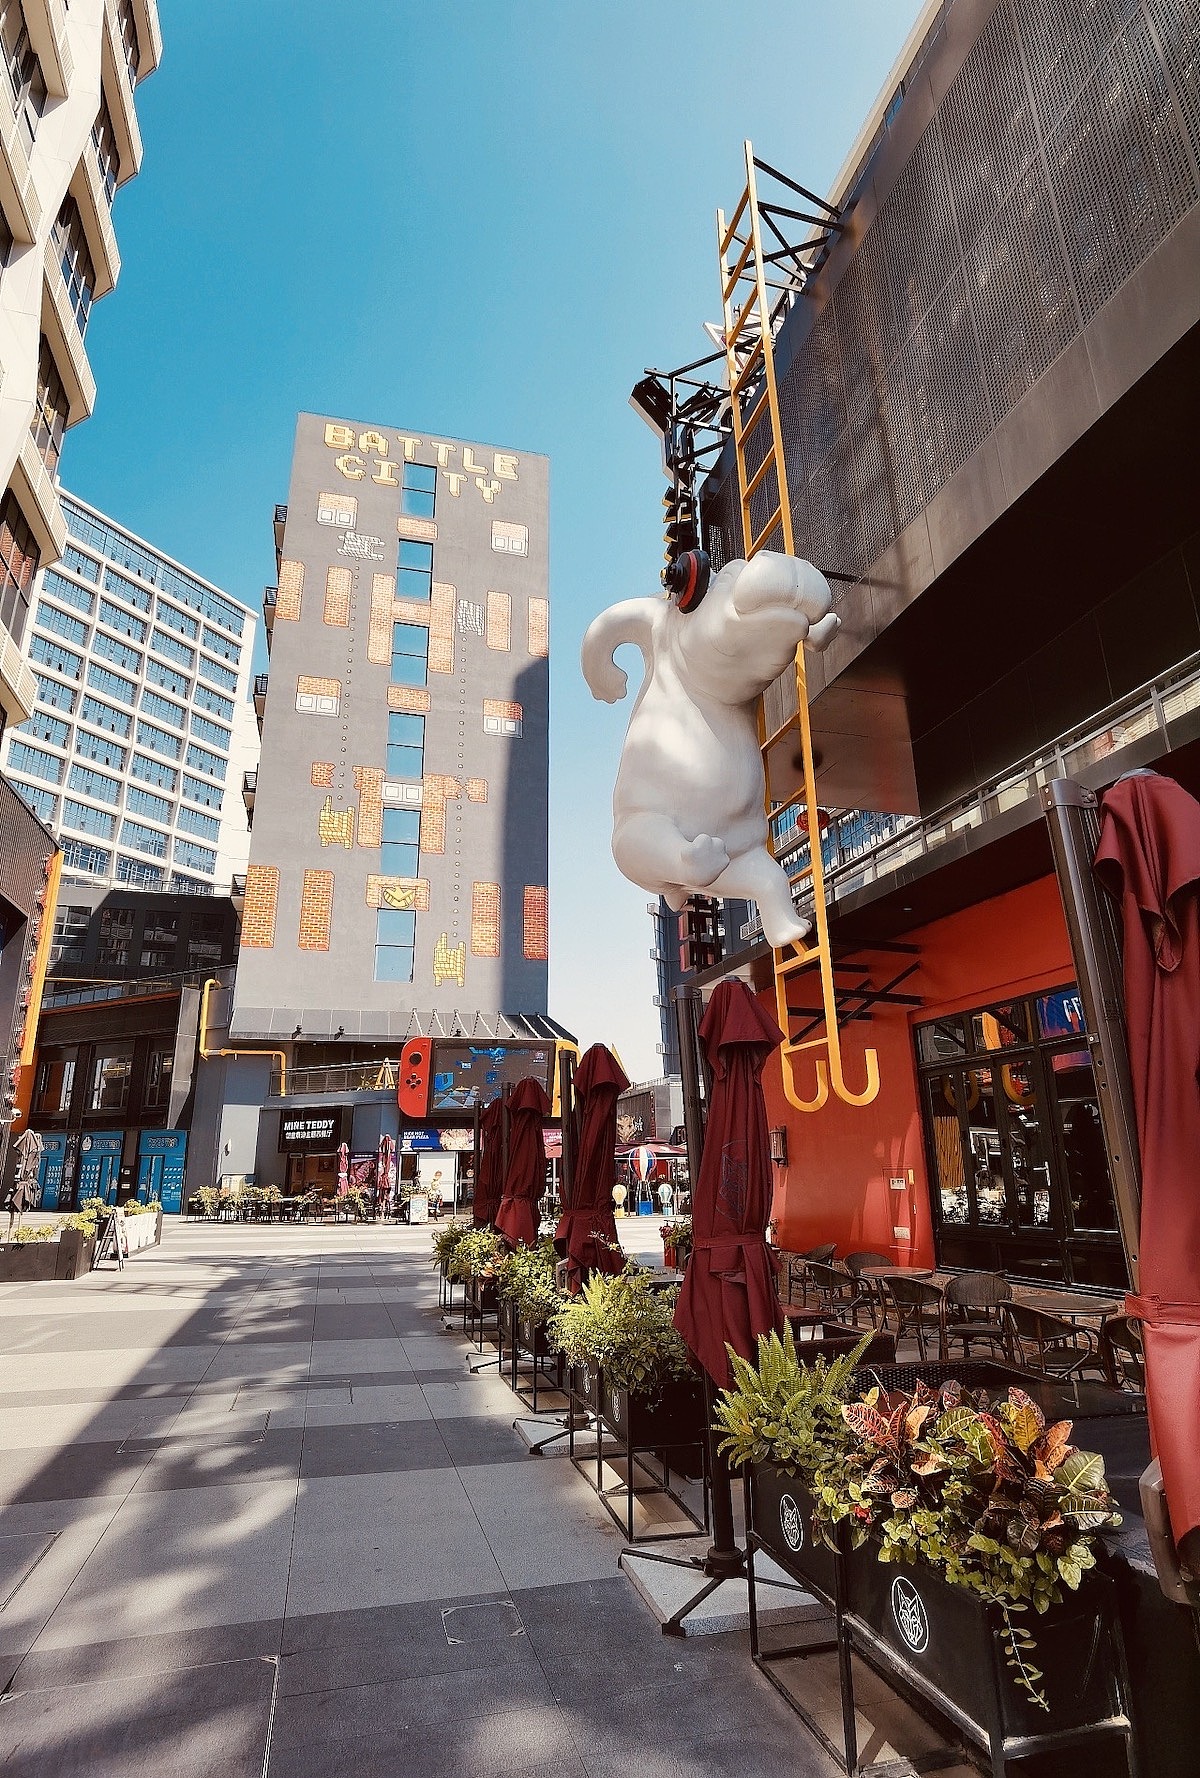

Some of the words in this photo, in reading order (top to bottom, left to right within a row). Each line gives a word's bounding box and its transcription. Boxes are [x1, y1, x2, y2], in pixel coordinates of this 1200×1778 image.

[324, 423, 519, 481] BATTLE
[284, 1121, 305, 1130] MINE
[305, 1119, 334, 1129] TEDDY
